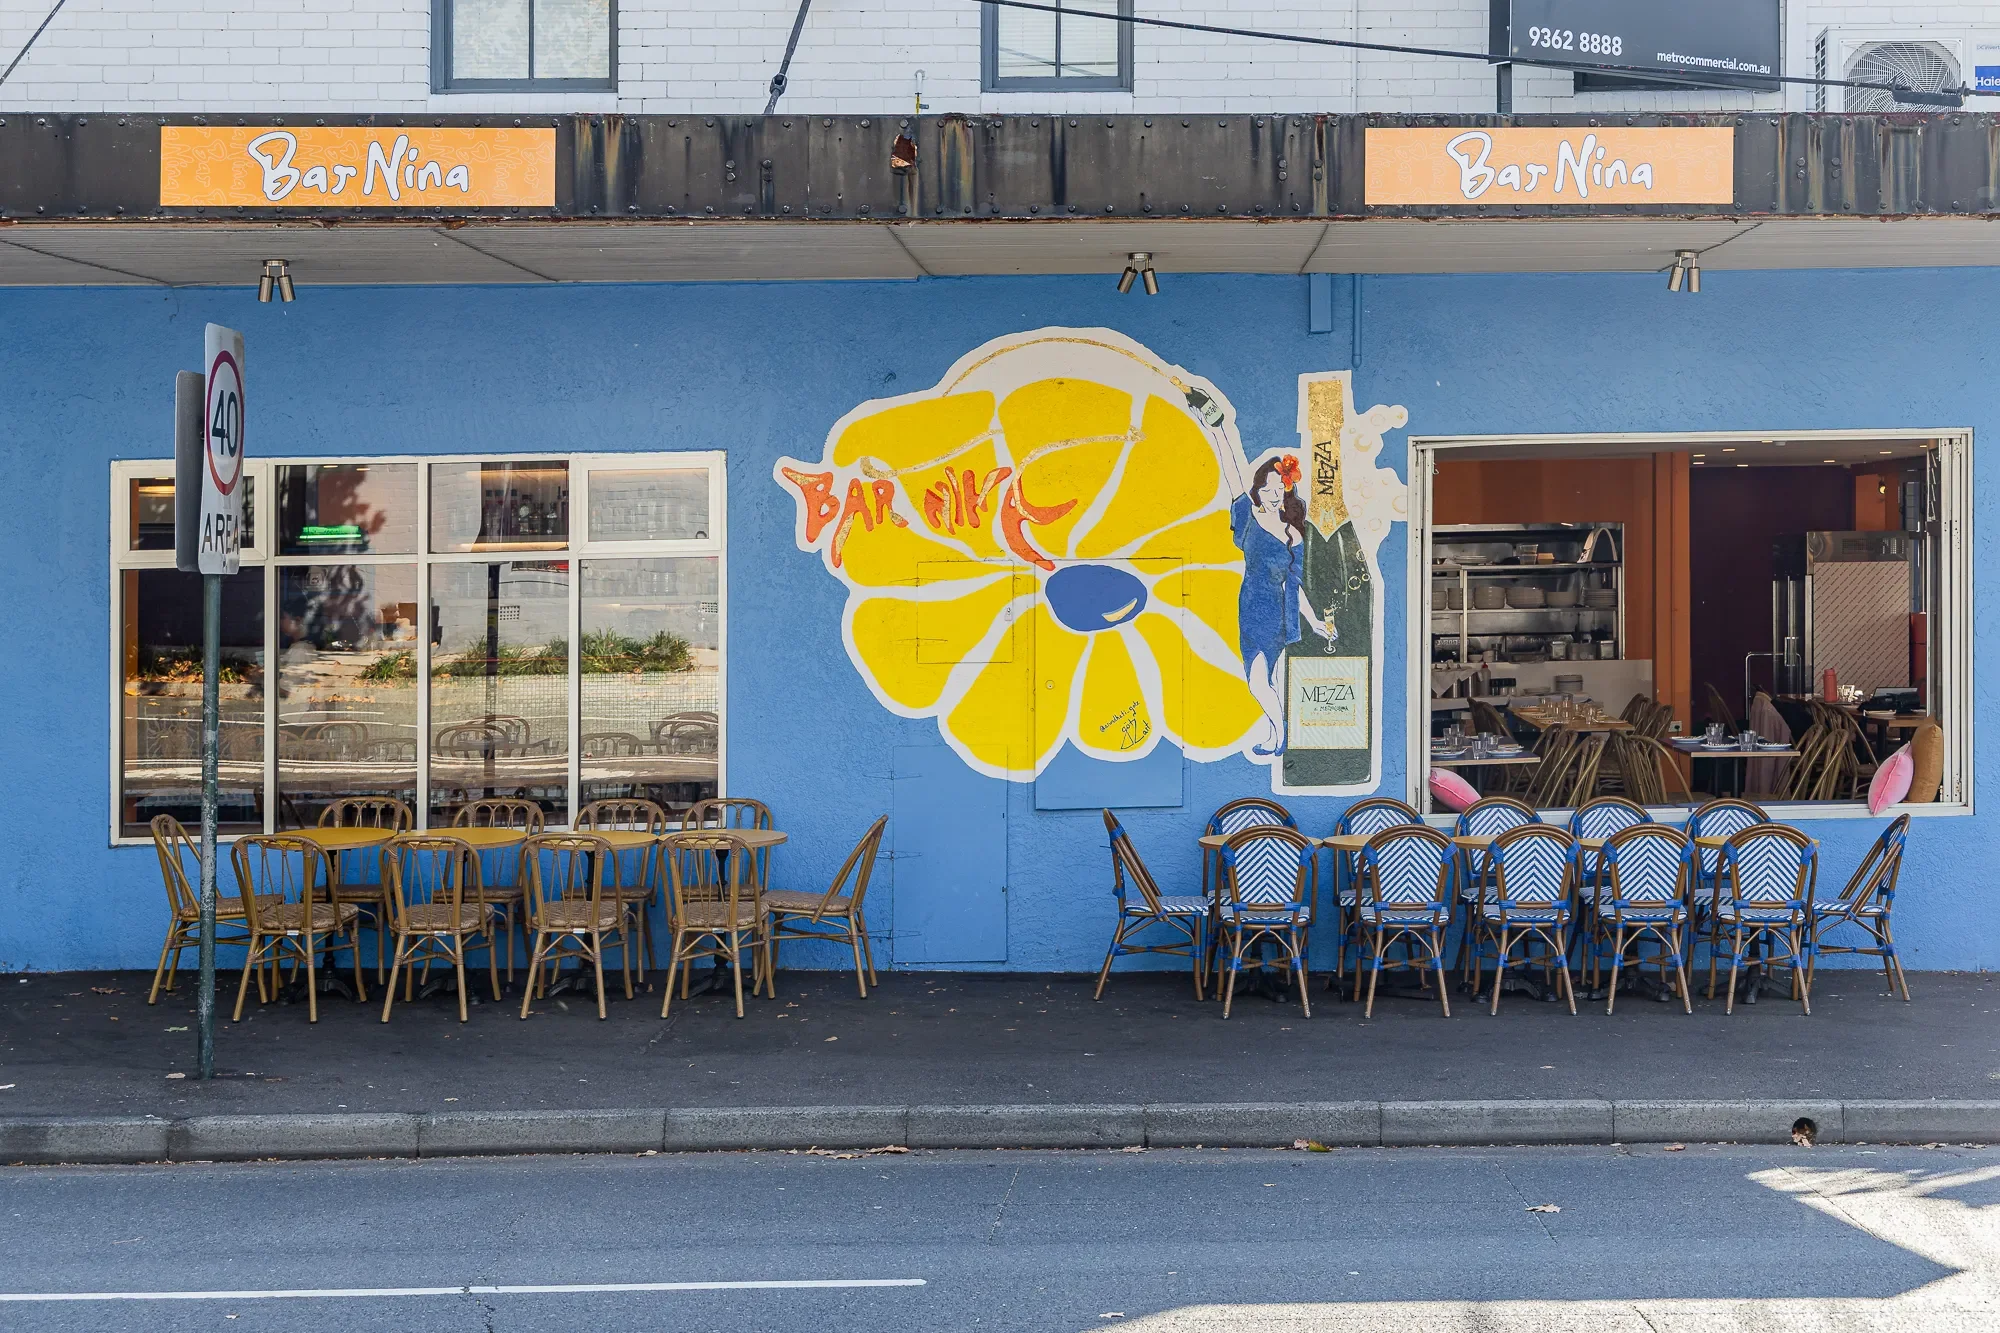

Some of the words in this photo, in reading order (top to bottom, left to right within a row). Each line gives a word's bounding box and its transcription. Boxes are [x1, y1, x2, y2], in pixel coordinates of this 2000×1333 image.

[1529, 27, 1573, 51] 9362
[1580, 32, 1622, 56] 8888
[1657, 51, 1771, 74] metrocommercial.com.au
[248, 131, 357, 202] Bar
[363, 135, 469, 201] Nina
[1446, 131, 1548, 199] Bar
[1554, 134, 1653, 198] Nina
[212, 389, 239, 458] 40
[1314, 440, 1339, 495] MEZZA
[201, 512, 239, 555] AREA
[781, 466, 909, 568] BAR
[1301, 684, 1355, 705] MEZZA
